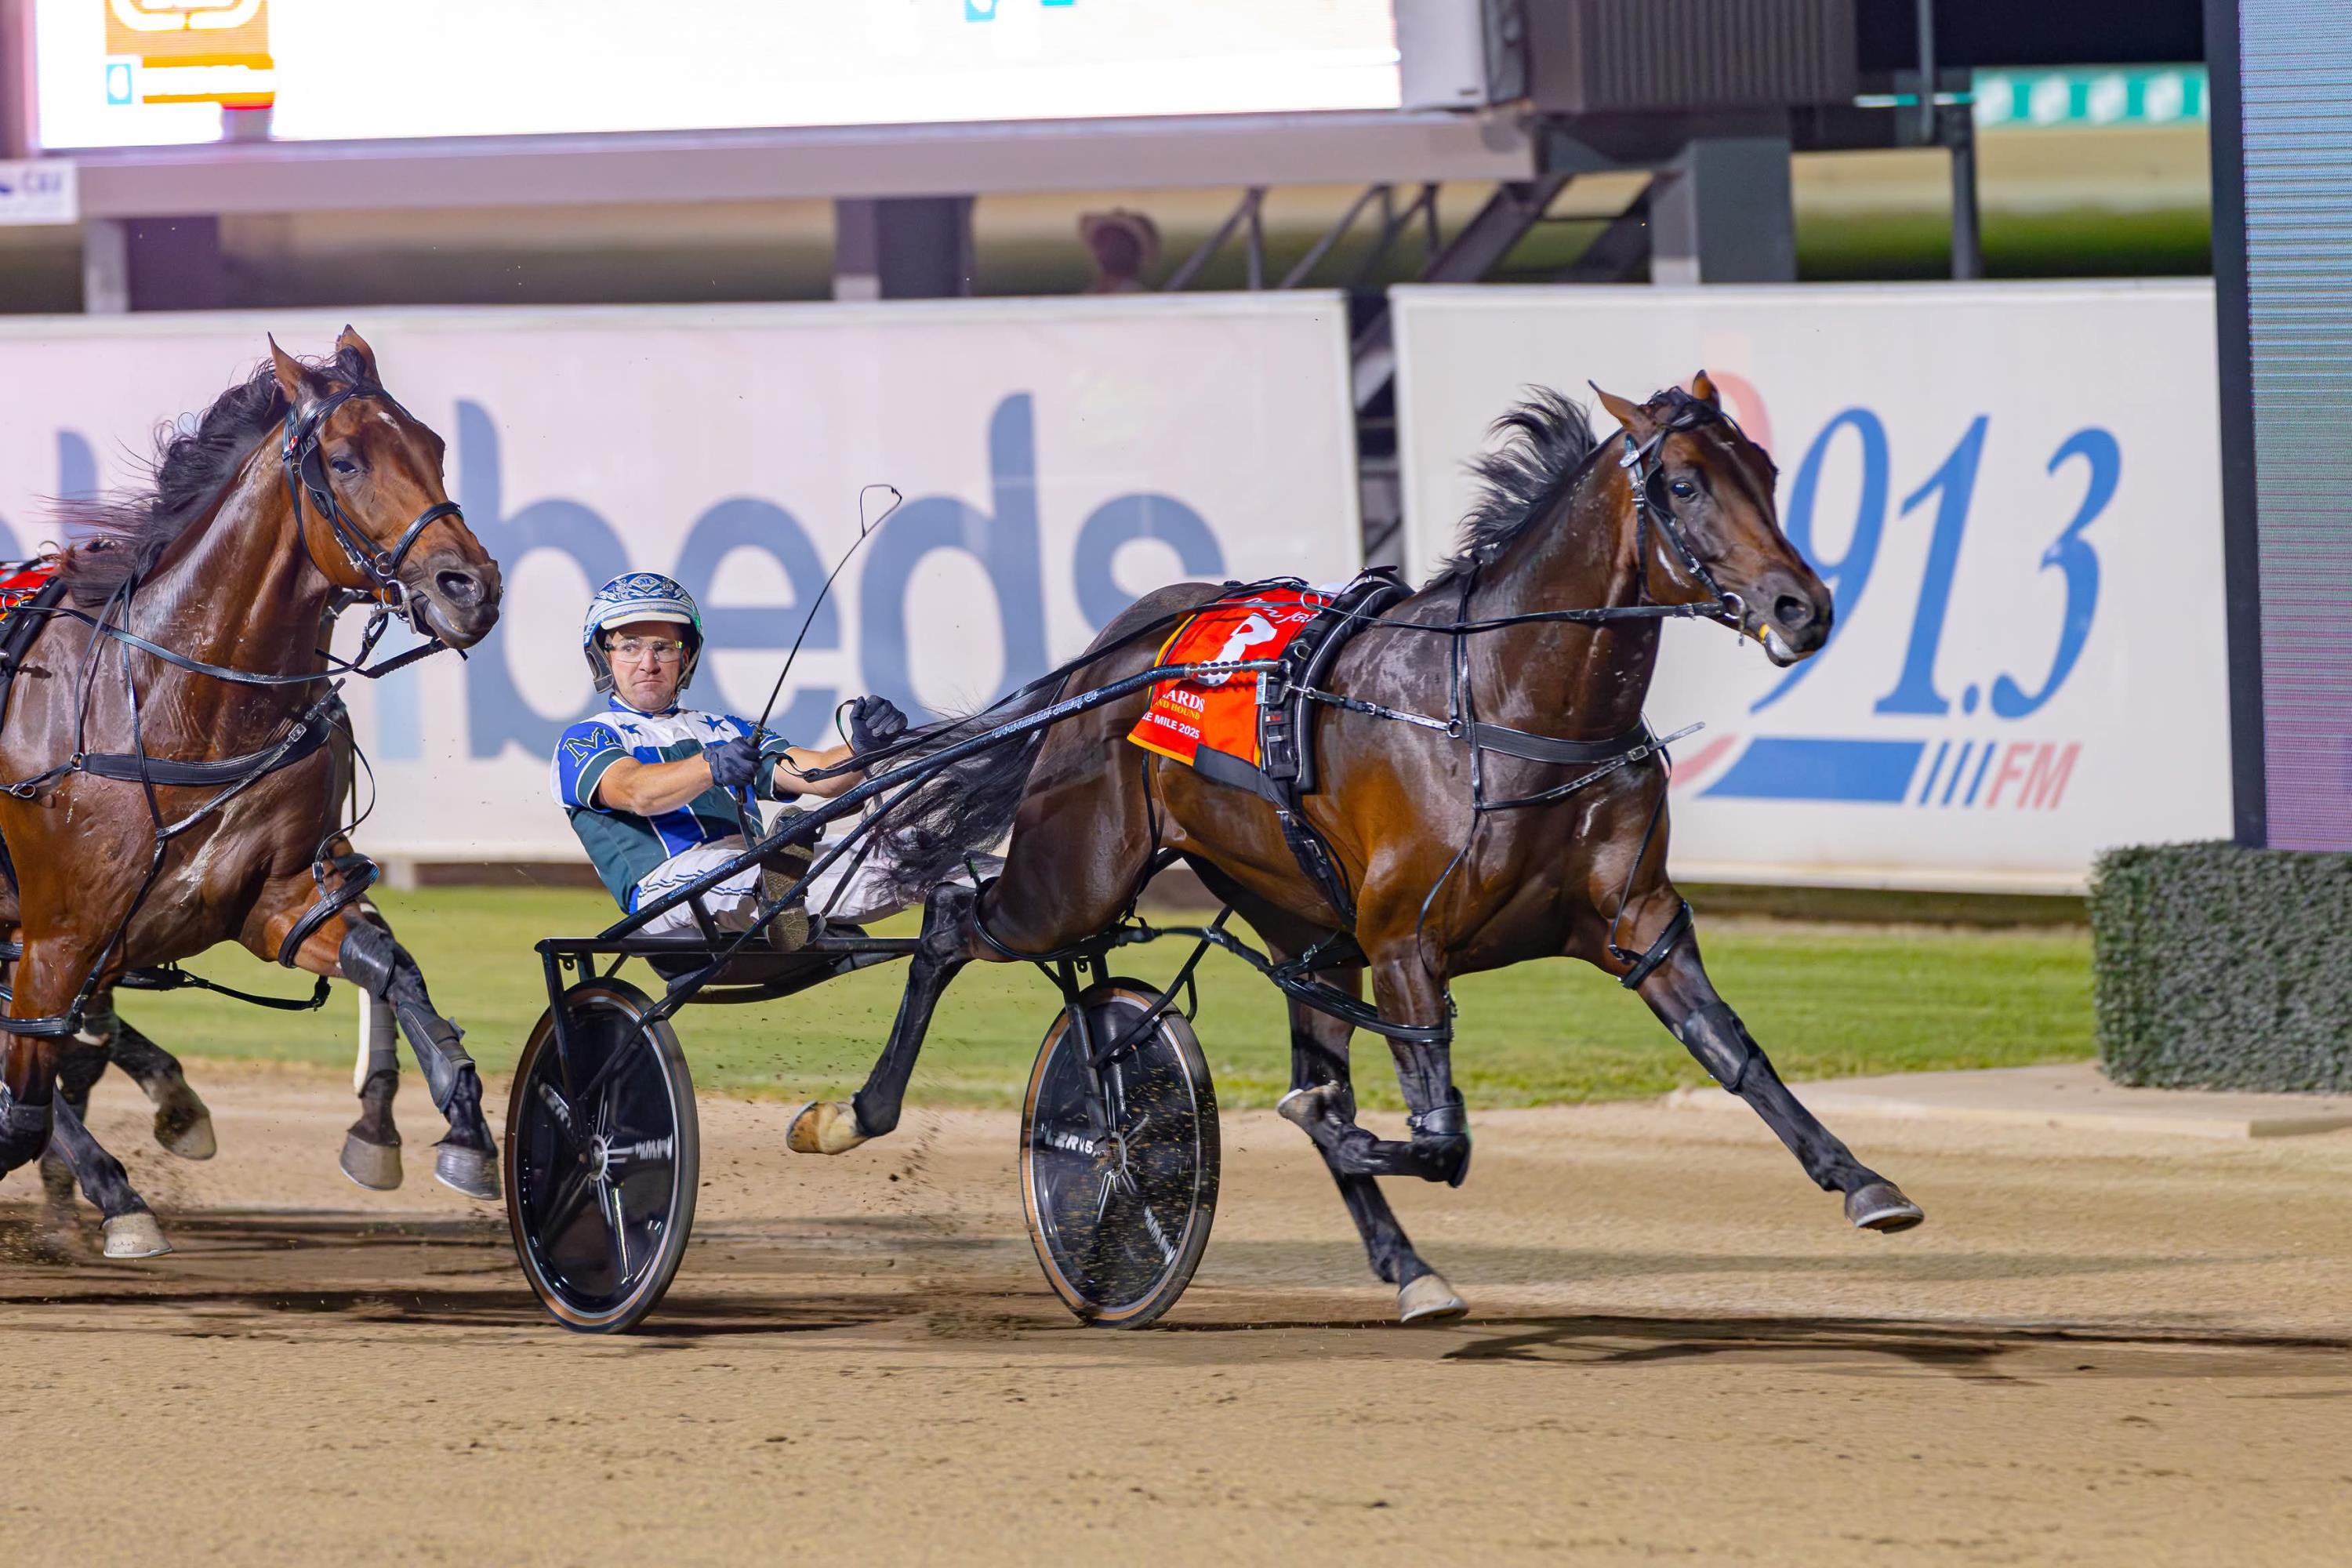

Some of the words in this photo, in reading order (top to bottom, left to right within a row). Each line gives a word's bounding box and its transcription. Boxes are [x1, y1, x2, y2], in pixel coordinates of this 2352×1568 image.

[1749, 406, 2122, 720] 91.3
[1162, 688, 1205, 713] ARDS
[1171, 702, 1200, 720] HOUND
[1154, 714, 1178, 730] MILE
[1178, 723, 1200, 739] 2025
[562, 727, 622, 768] M
[1986, 742, 2083, 811] FM
